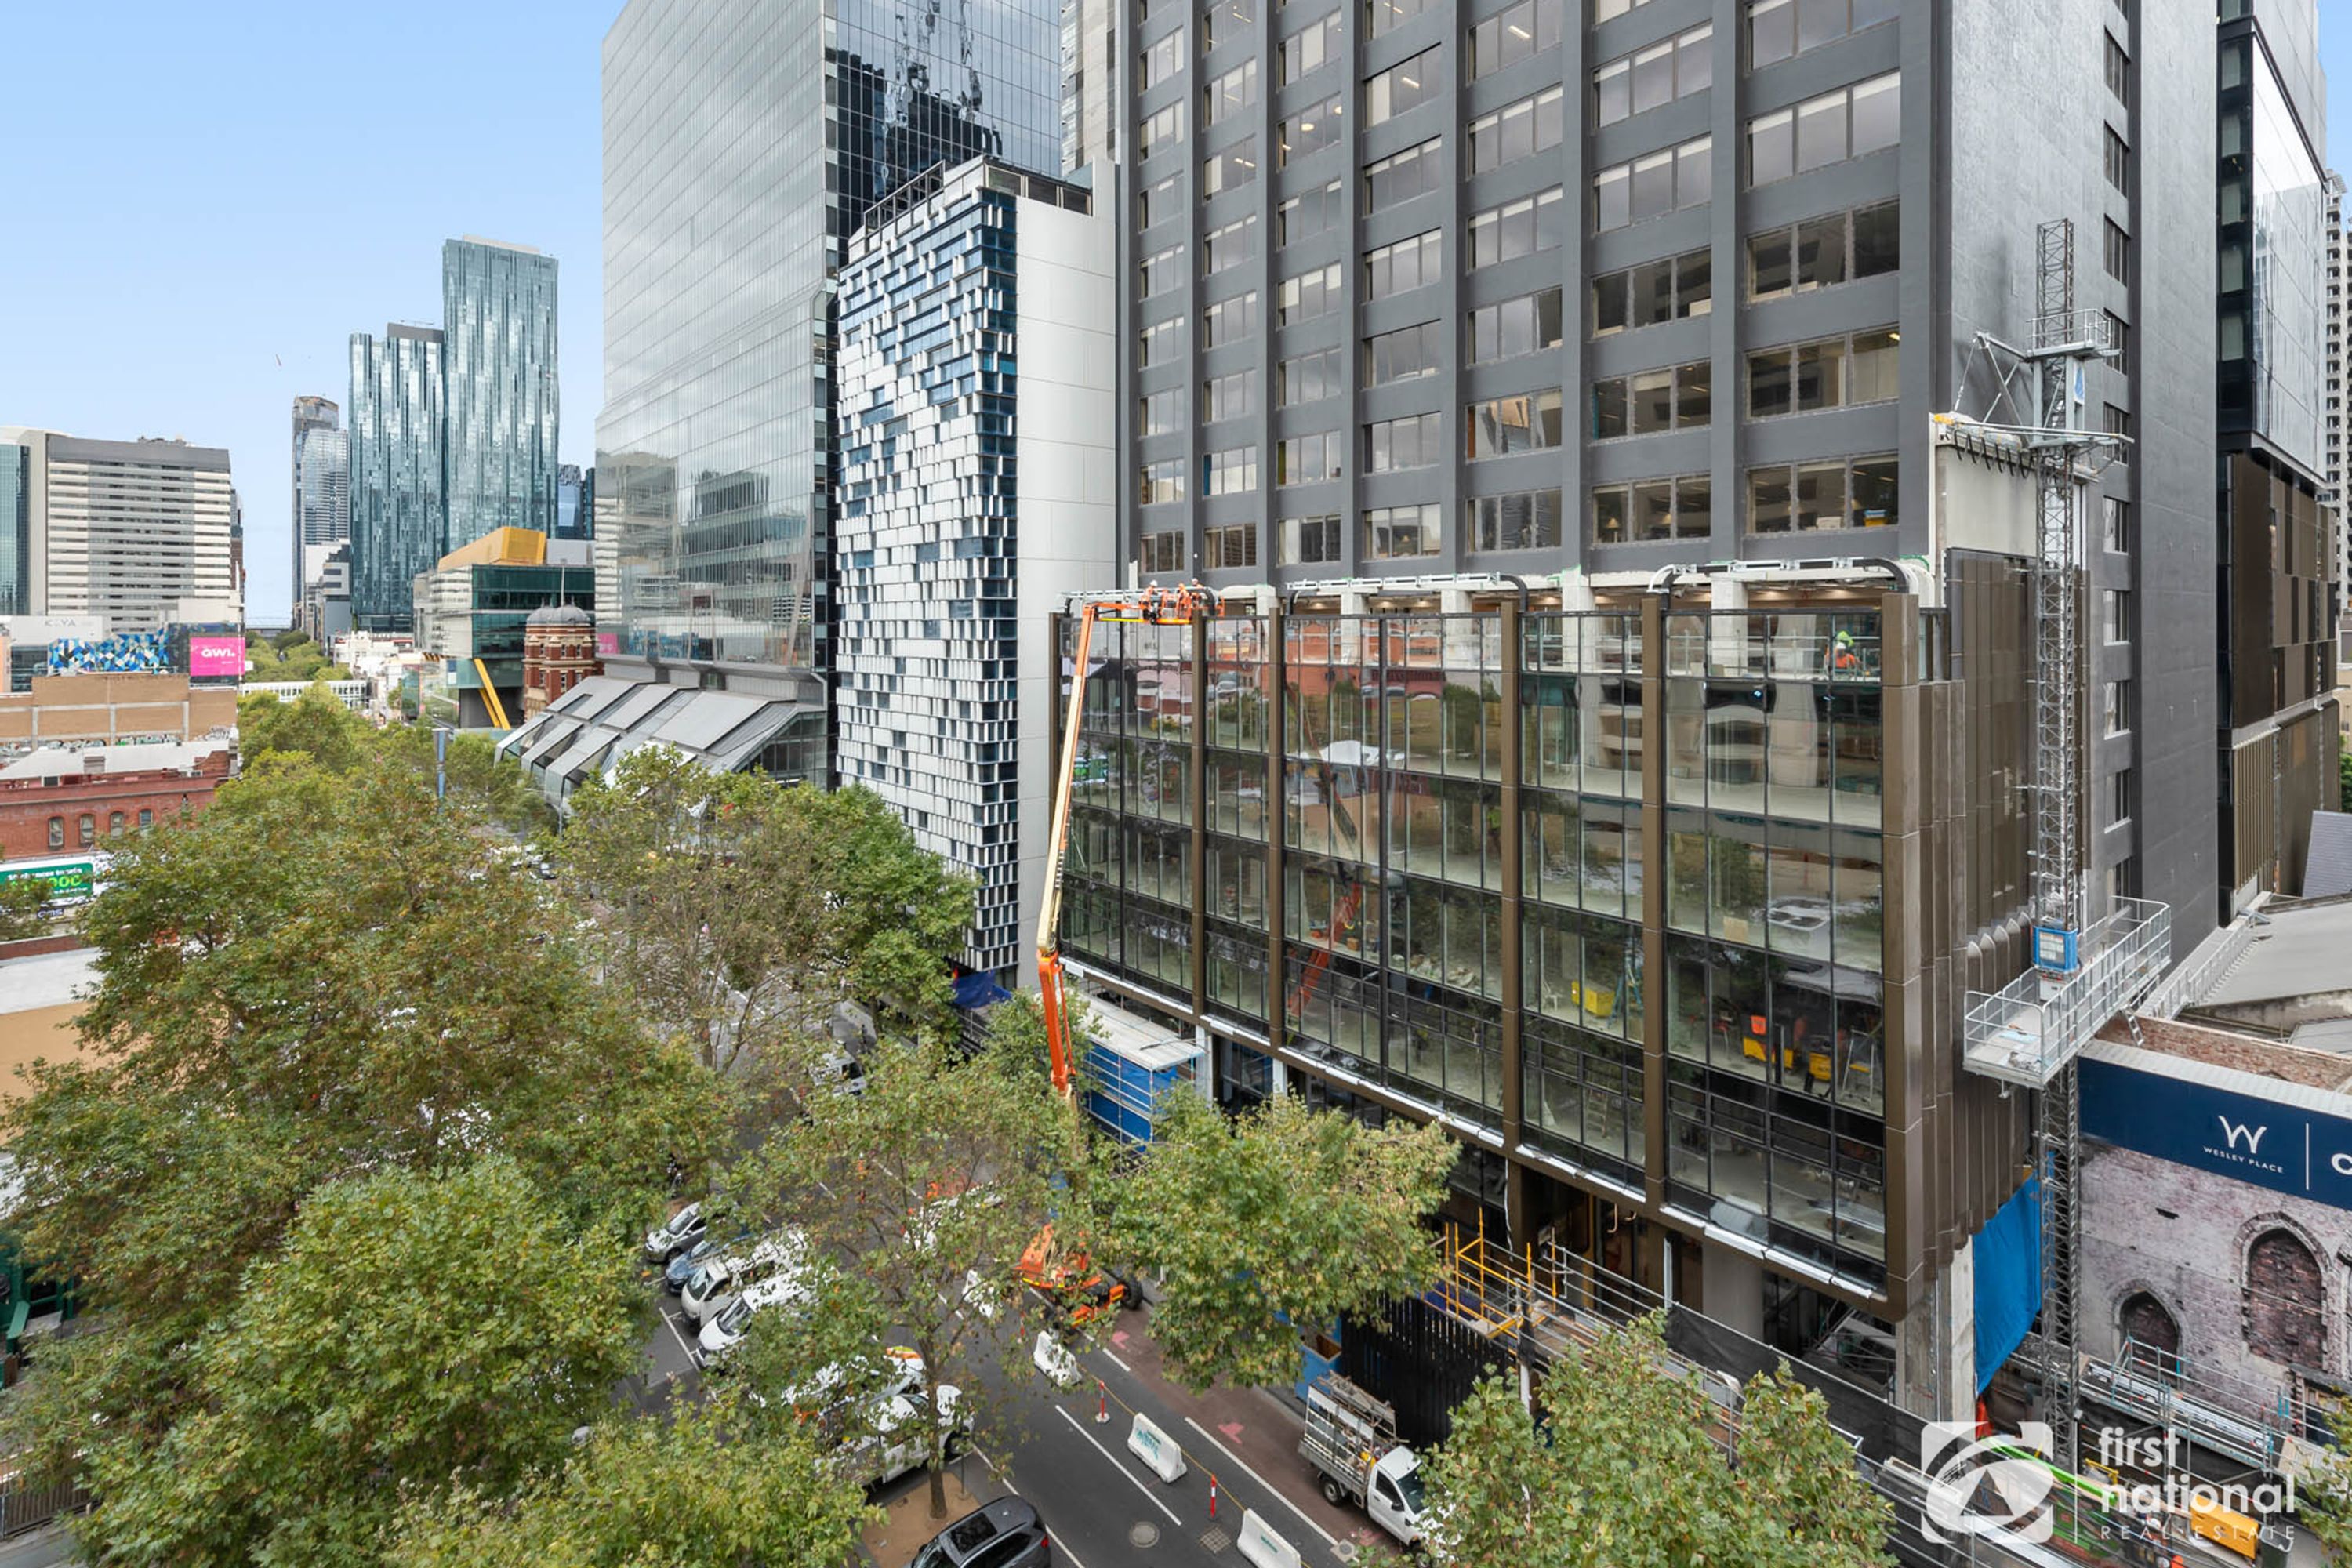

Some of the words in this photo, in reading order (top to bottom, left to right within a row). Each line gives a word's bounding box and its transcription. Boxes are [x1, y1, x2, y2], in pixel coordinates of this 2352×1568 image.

[45, 619, 76, 627] KYA
[2202, 1145, 2245, 1163] WESLEY
[2248, 1158, 2285, 1174] PLACE
